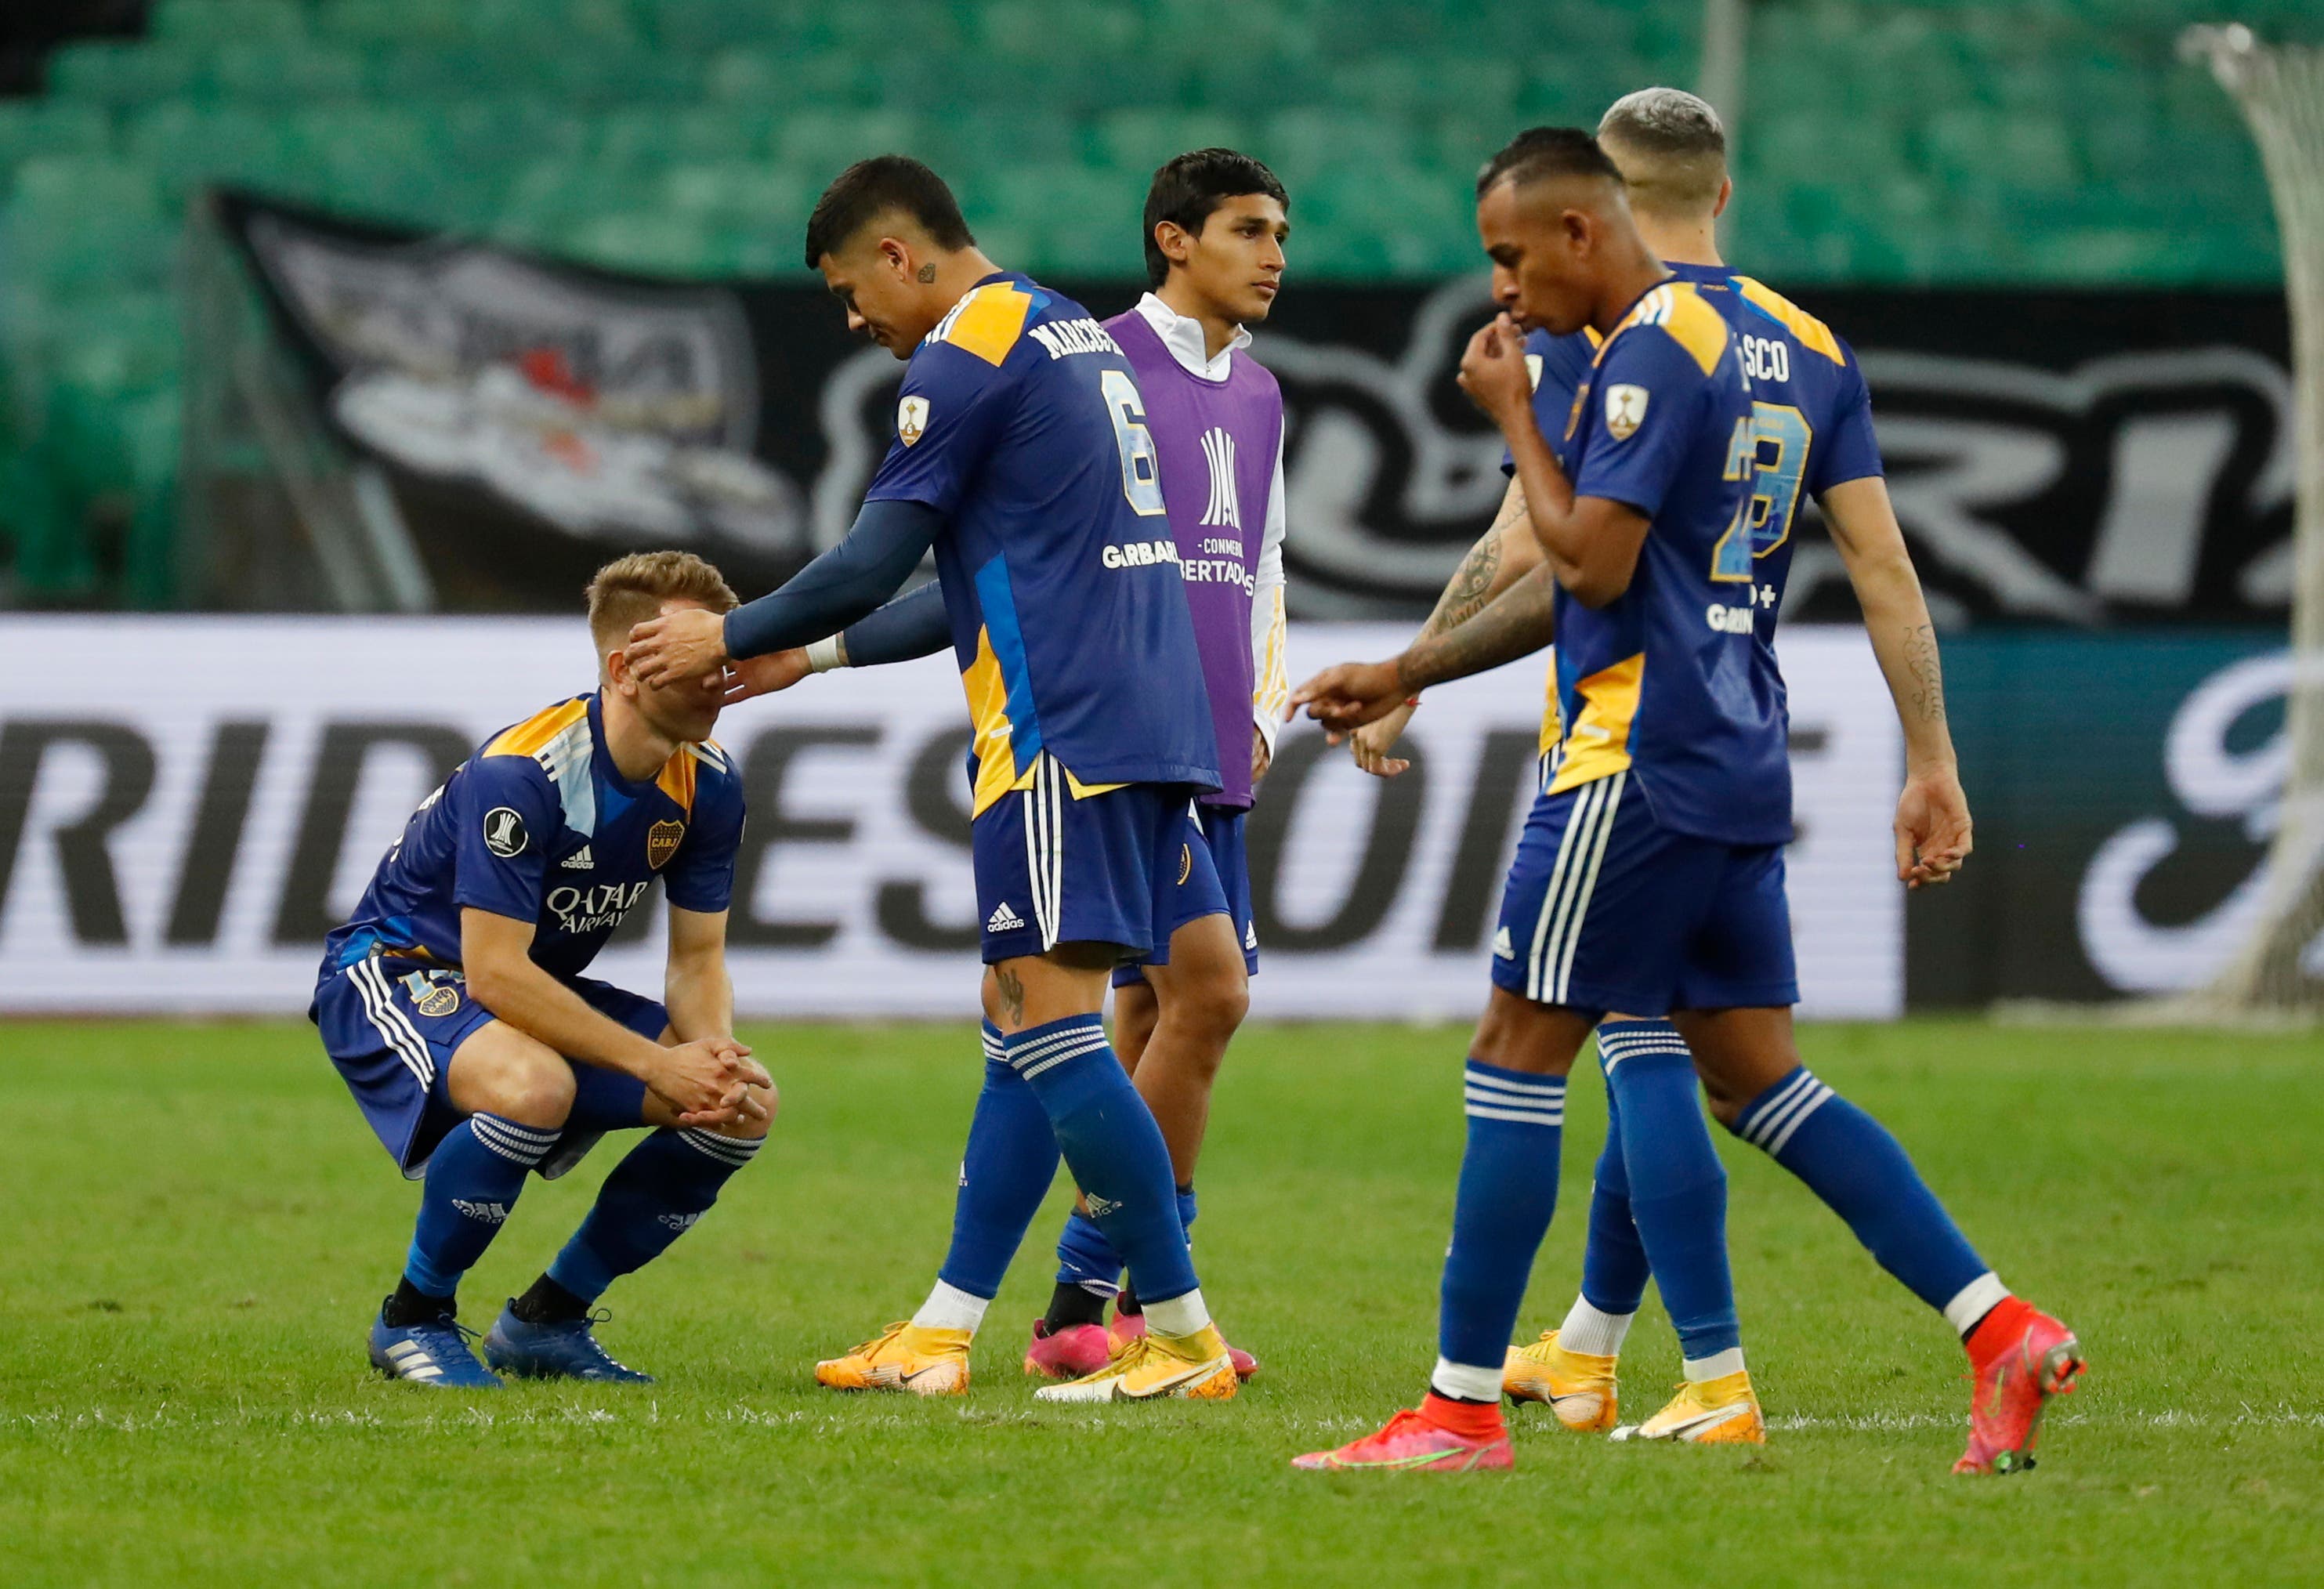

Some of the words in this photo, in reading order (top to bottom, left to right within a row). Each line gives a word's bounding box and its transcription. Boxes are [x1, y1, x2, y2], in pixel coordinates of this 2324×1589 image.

[1101, 370, 1166, 516] 6
[652, 838, 678, 848] CABJ
[561, 860, 595, 870] adidas
[547, 881, 648, 921] QATAR
[987, 918, 1025, 932] adidas
